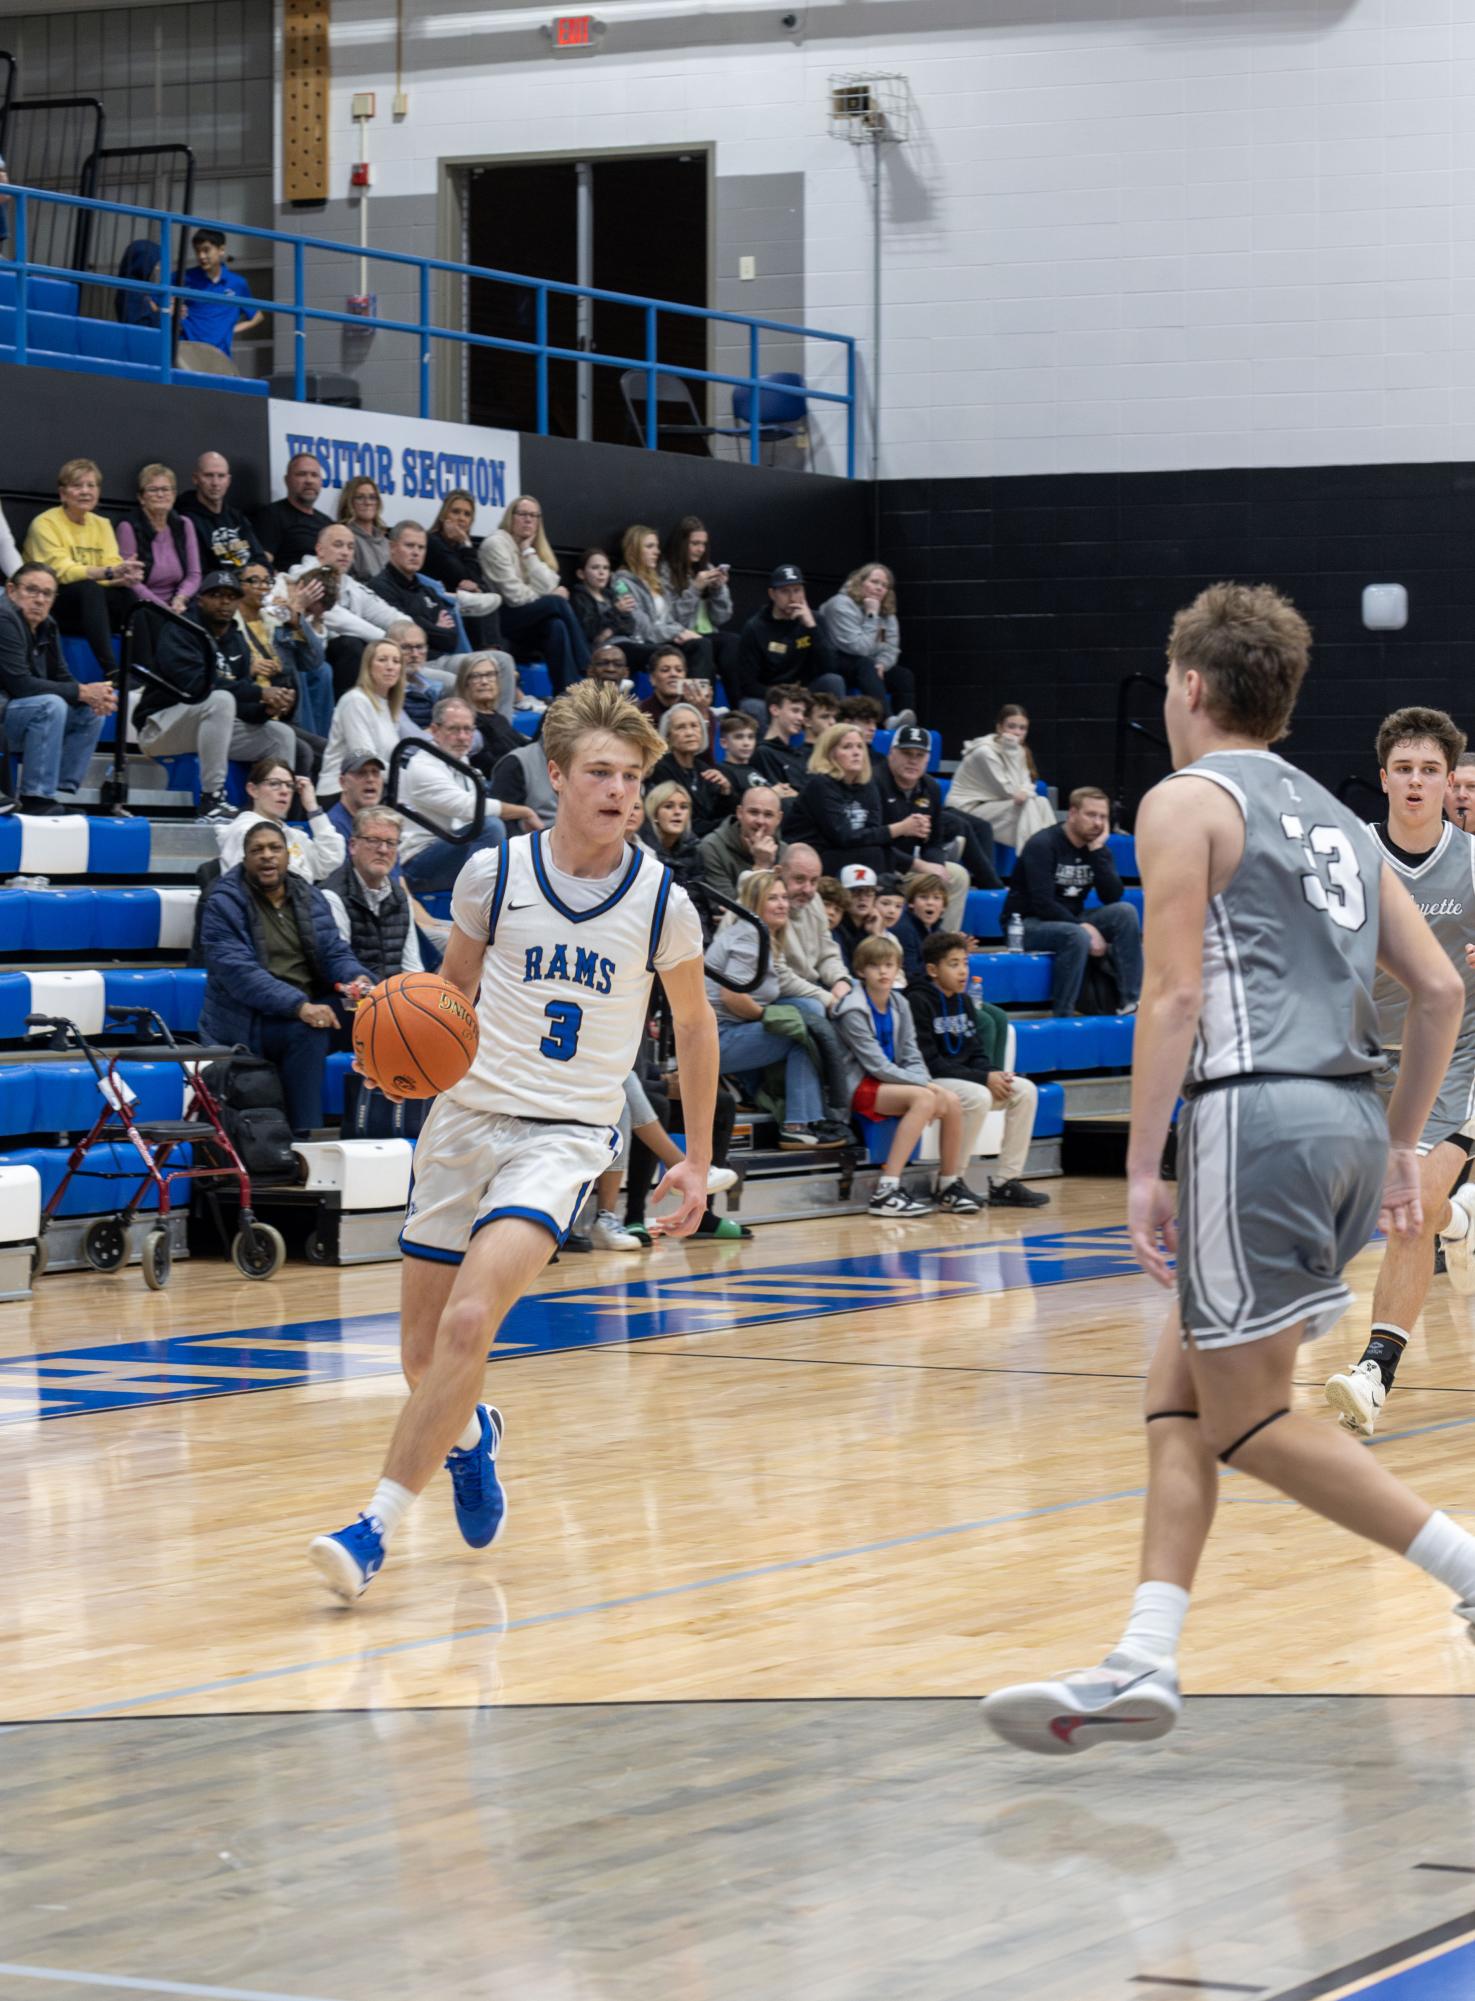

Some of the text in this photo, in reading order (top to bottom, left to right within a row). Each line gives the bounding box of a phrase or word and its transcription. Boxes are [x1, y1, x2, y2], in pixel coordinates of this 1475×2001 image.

[557, 17, 589, 45] EXIT
[402, 448, 506, 508] SECTION
[1410, 893, 1463, 917] yette
[523, 943, 617, 995] RAMS
[438, 992, 479, 1043] LDING
[539, 999, 584, 1063] 3
